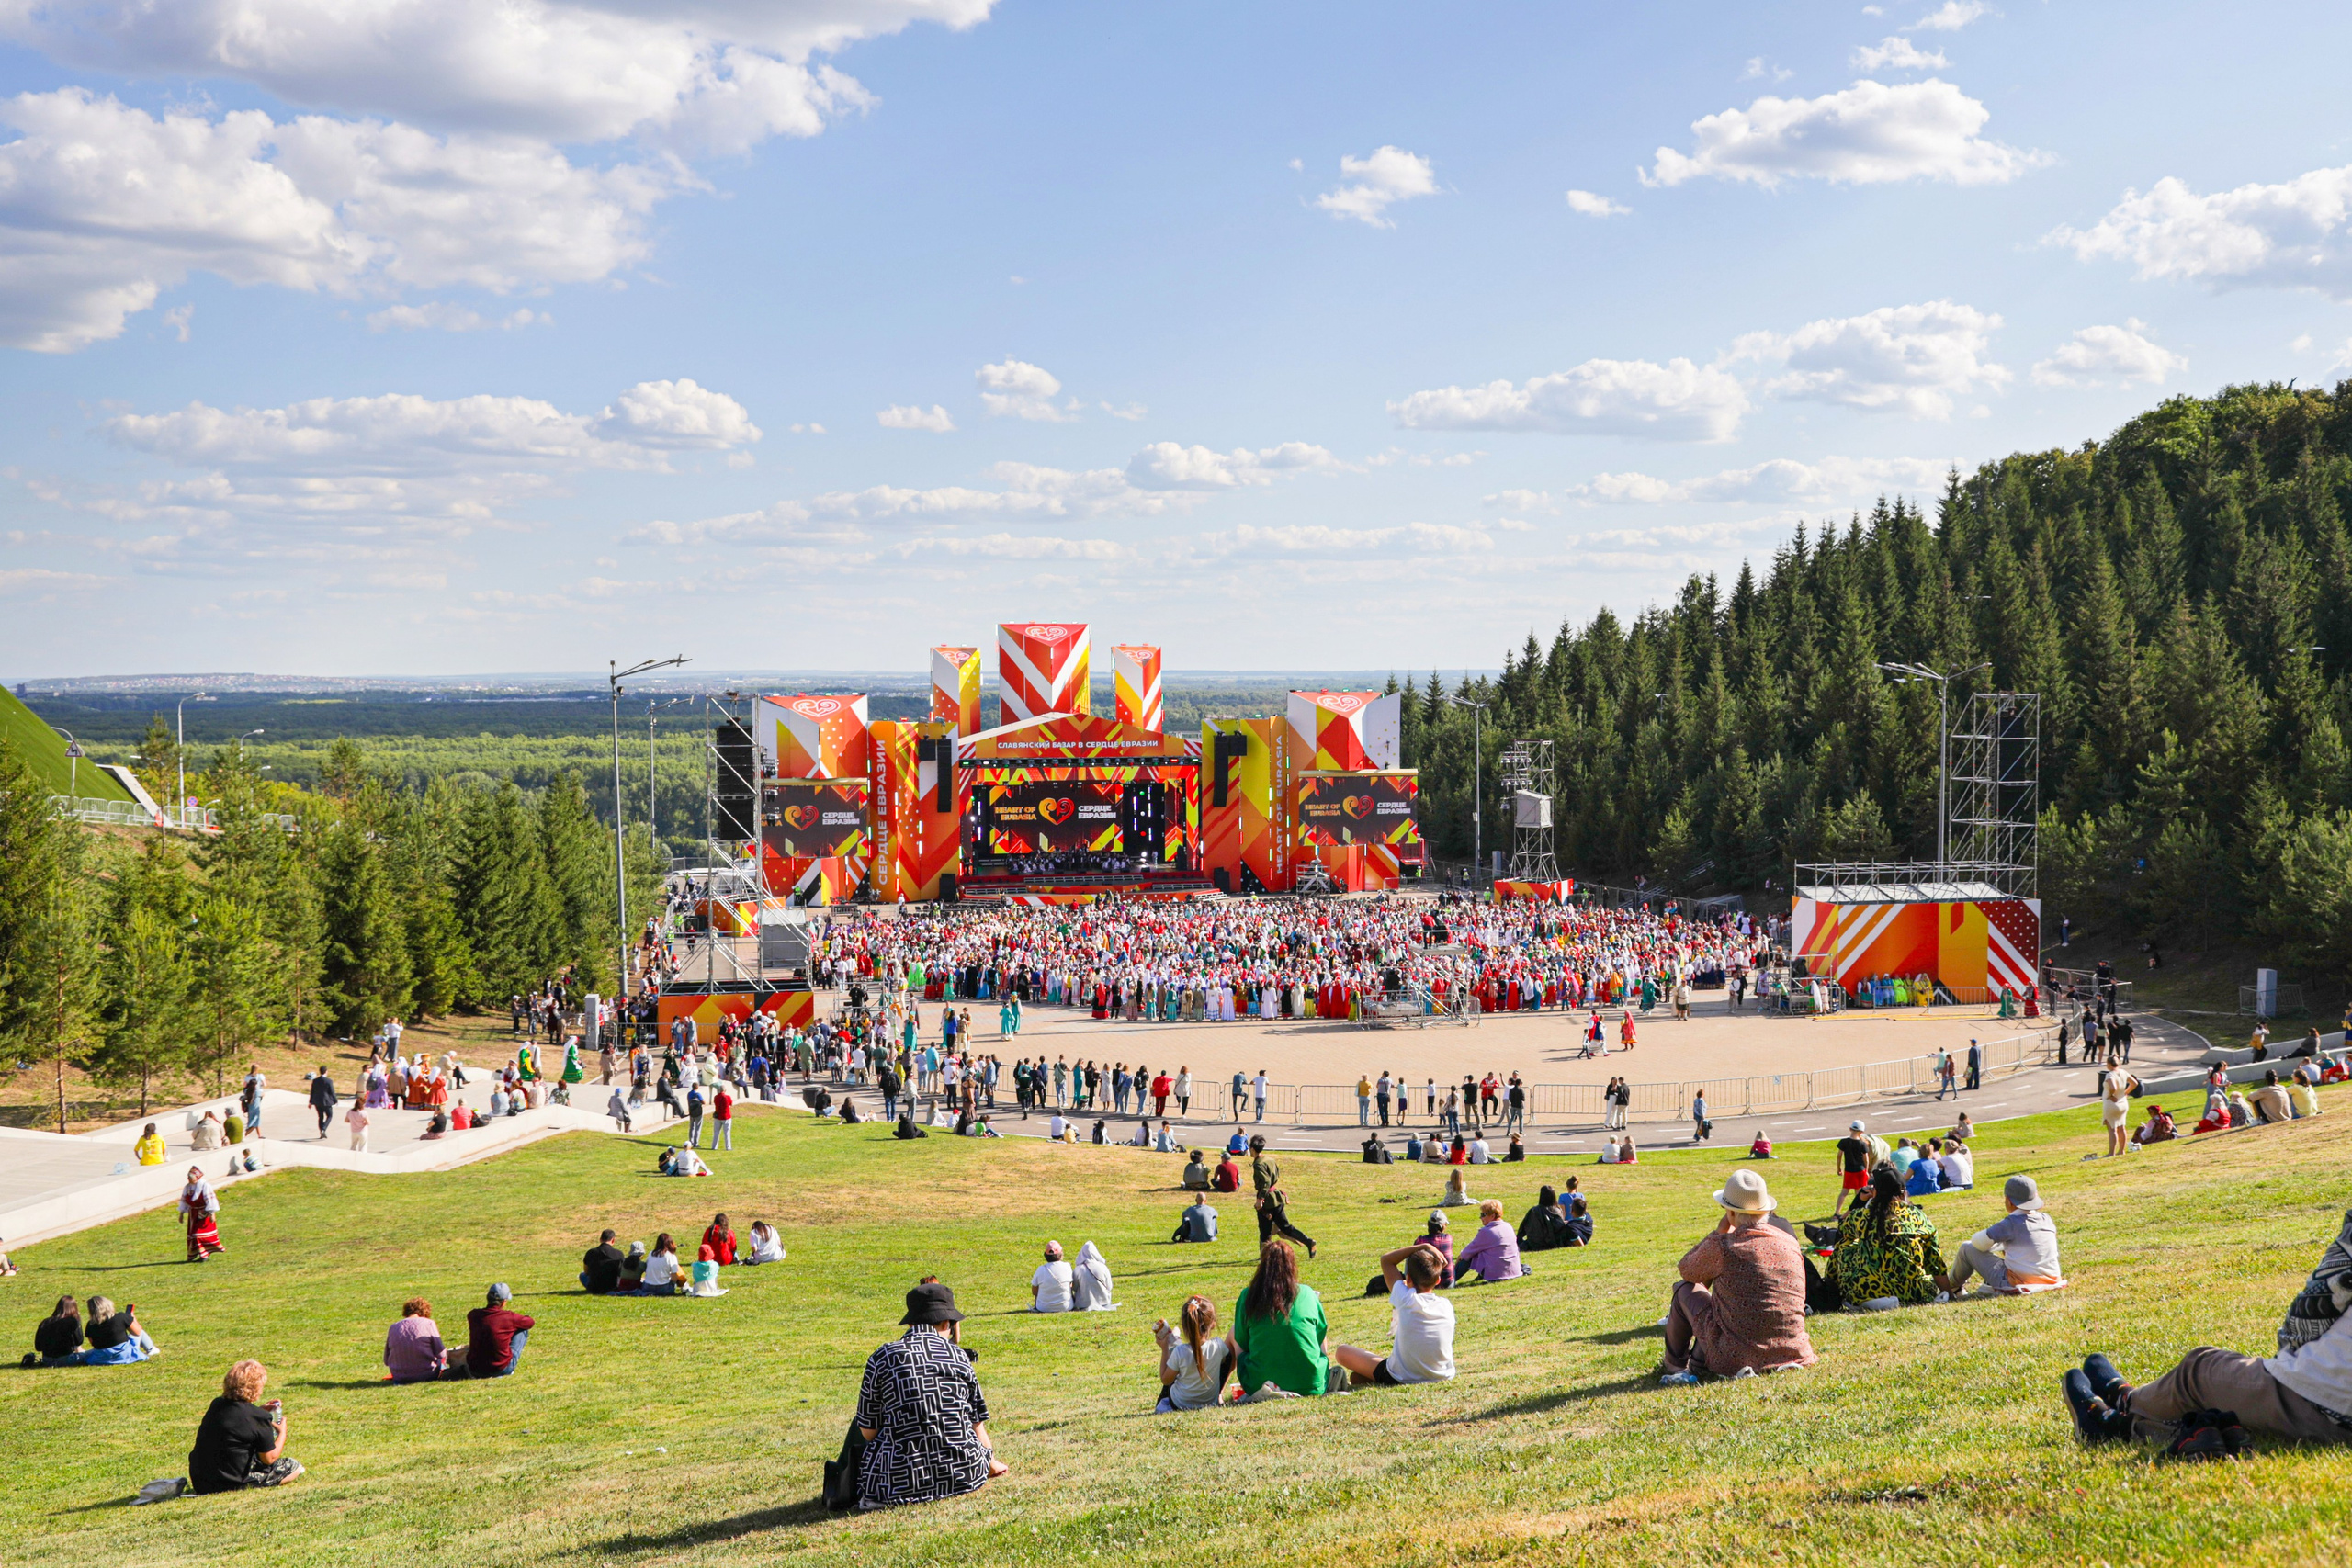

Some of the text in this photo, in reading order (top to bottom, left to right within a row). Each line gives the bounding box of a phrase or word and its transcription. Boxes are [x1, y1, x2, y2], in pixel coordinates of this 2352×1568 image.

[998, 740, 1050, 749] СЛАВЯНСКИЙ
[877, 740, 888, 886] СЕРДЦЕ ЕВРАЗИИ
[1276, 803, 1283, 823] OF
